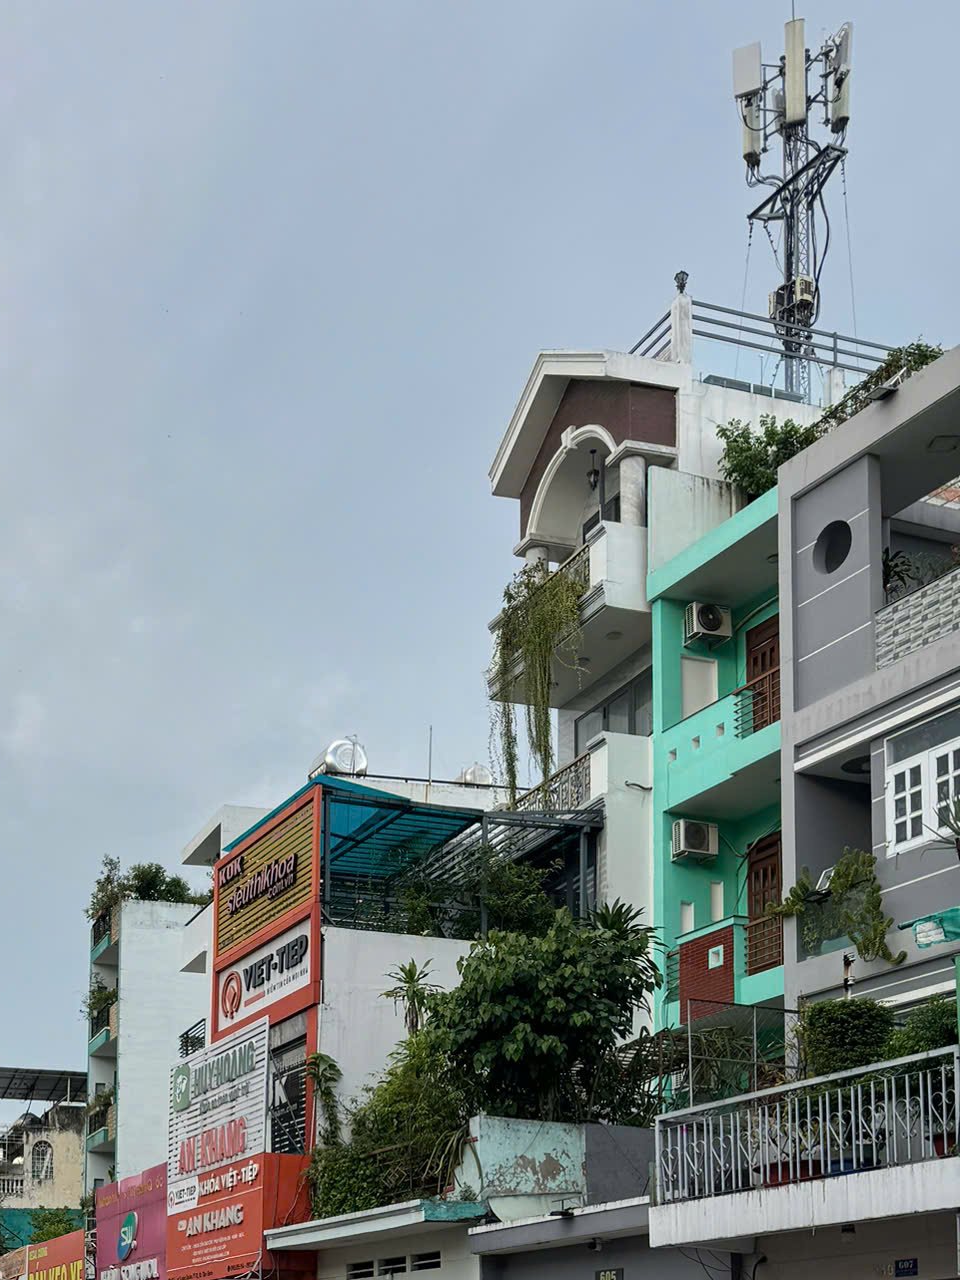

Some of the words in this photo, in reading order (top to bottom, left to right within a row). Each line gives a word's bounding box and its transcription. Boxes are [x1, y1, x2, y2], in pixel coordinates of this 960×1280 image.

[219, 856, 244, 886] KOK
[227, 853, 297, 915] sieuthikhoa
[178, 1135, 196, 1174] AN
[200, 1115, 249, 1168] KHANG
[199, 1173, 220, 1196] KHÓA
[186, 1214, 203, 1238] AN
[203, 1204, 244, 1233] KHANG
